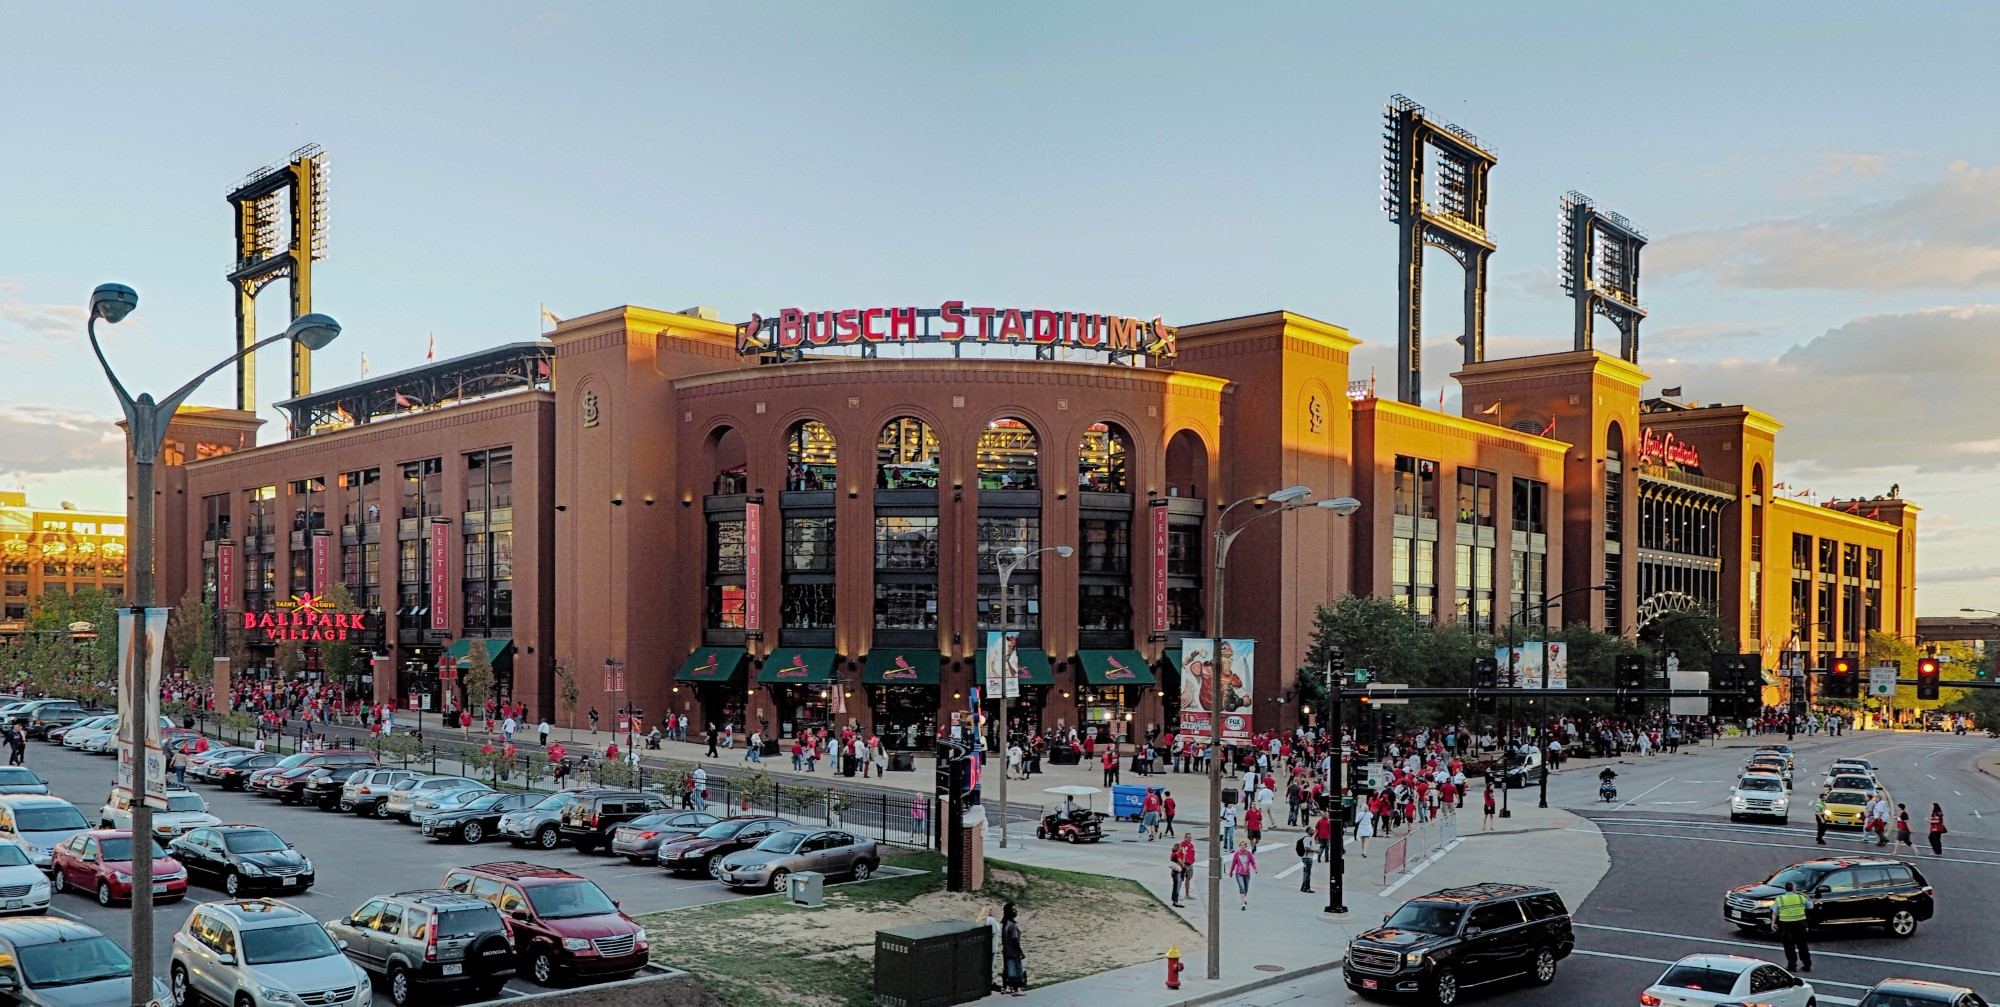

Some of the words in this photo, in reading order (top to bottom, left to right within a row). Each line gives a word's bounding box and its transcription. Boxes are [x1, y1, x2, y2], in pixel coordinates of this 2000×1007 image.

[780, 307, 917, 348] BUSCH
[940, 301, 1137, 351] STADIUM
[1664, 432, 1700, 468] Cardinals
[244, 612, 366, 630] BALLPARK
[266, 630, 348, 640] VILLAGE
